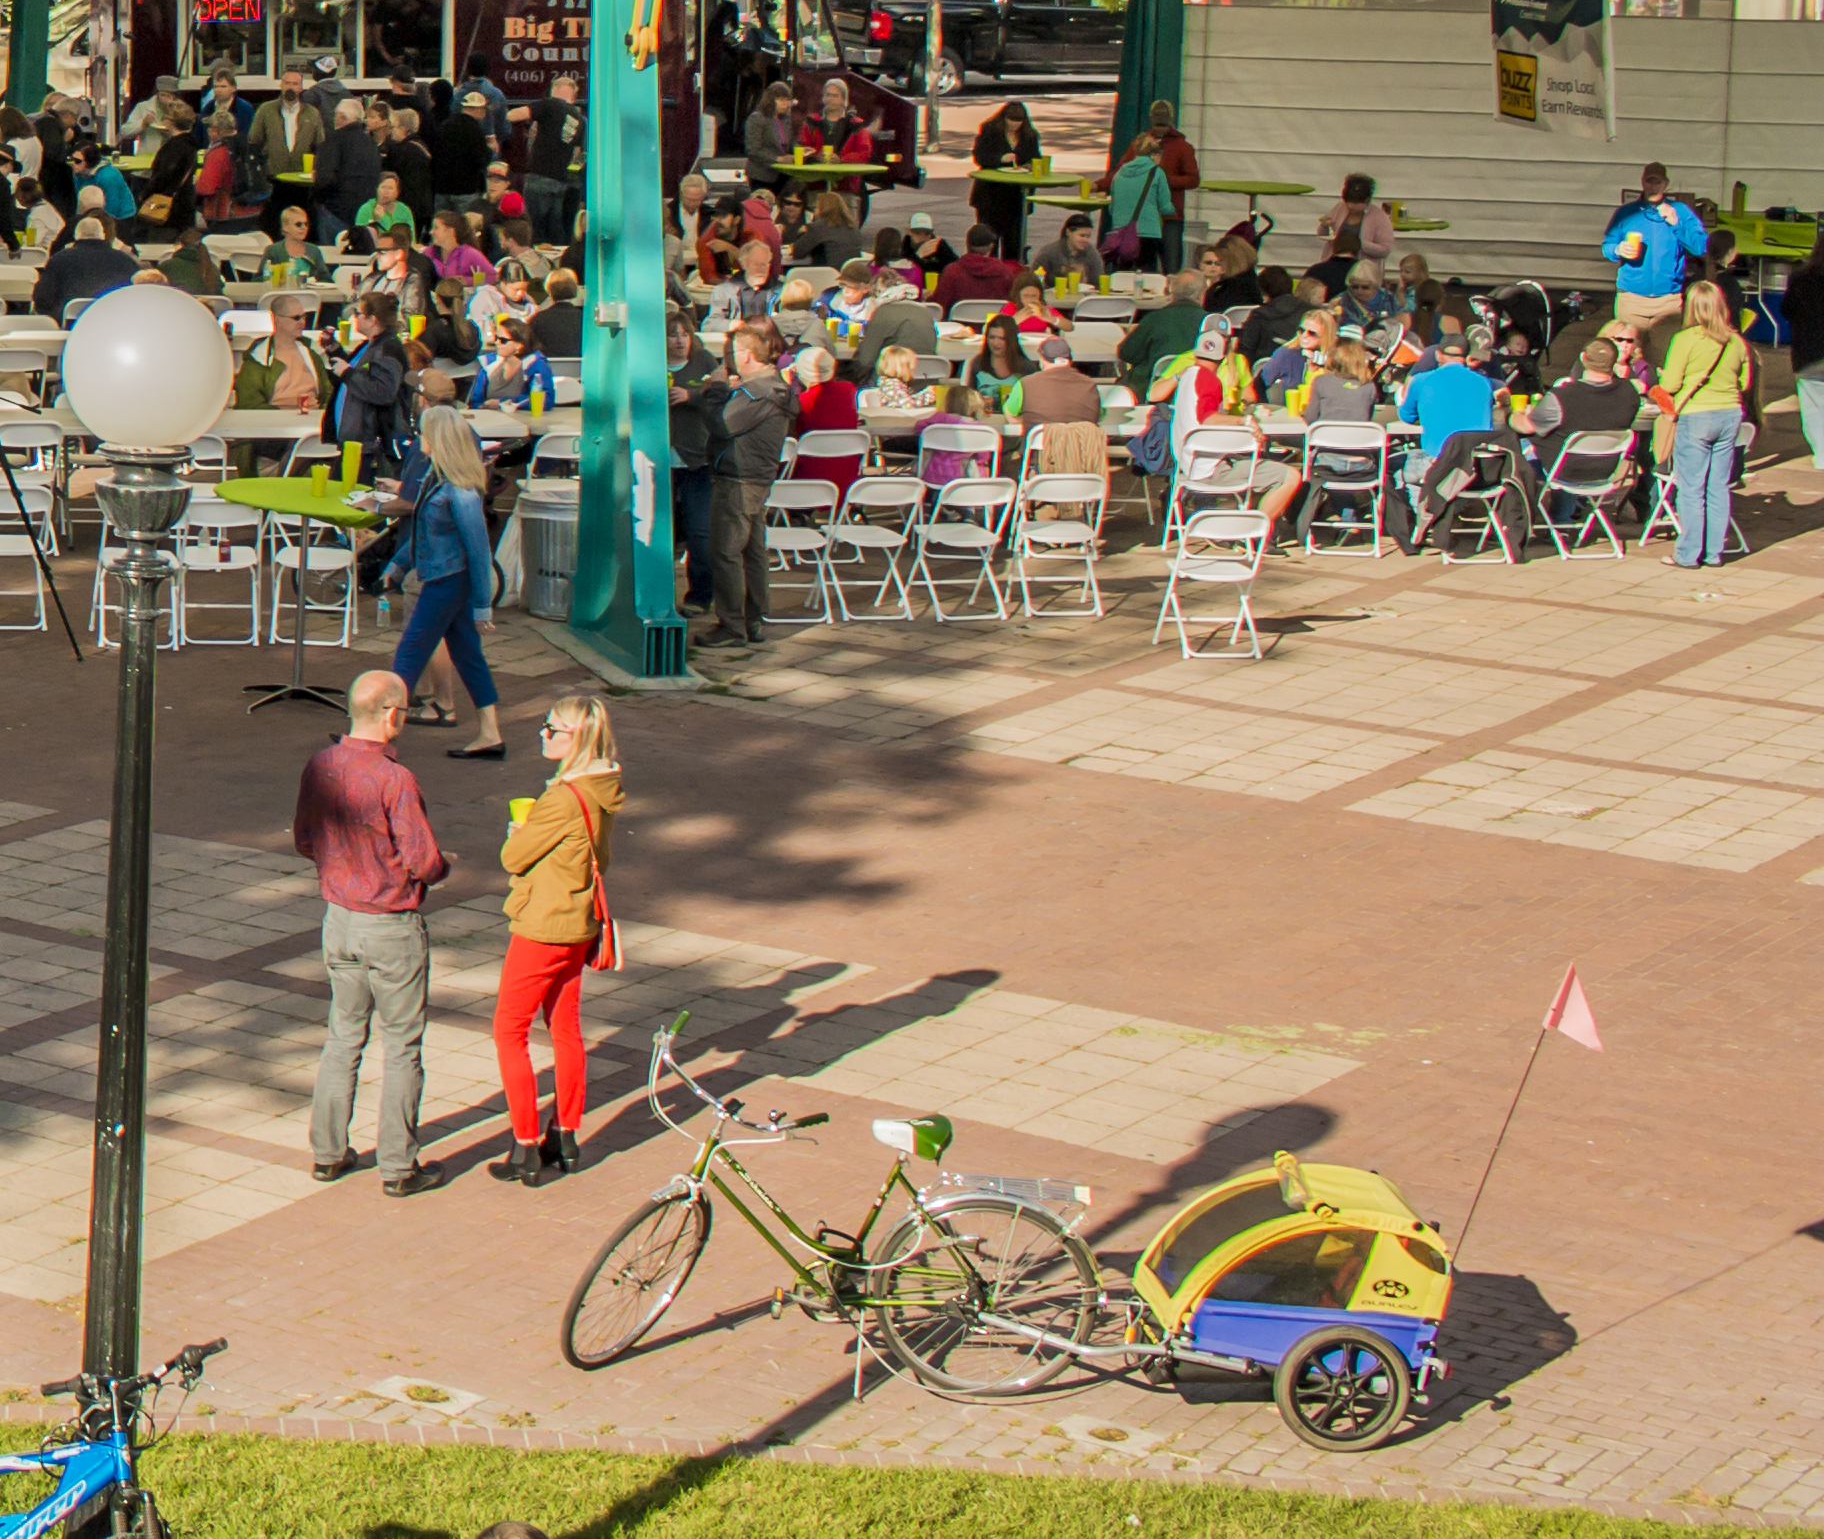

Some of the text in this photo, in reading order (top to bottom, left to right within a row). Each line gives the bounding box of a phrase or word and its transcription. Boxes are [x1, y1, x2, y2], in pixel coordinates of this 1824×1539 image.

[503, 14, 555, 45] Big
[502, 42, 590, 61] Count
[504, 69, 545, 83] (406)
[1547, 77, 1596, 95] Shop Local
[1542, 99, 1605, 120] Earn Rewards
